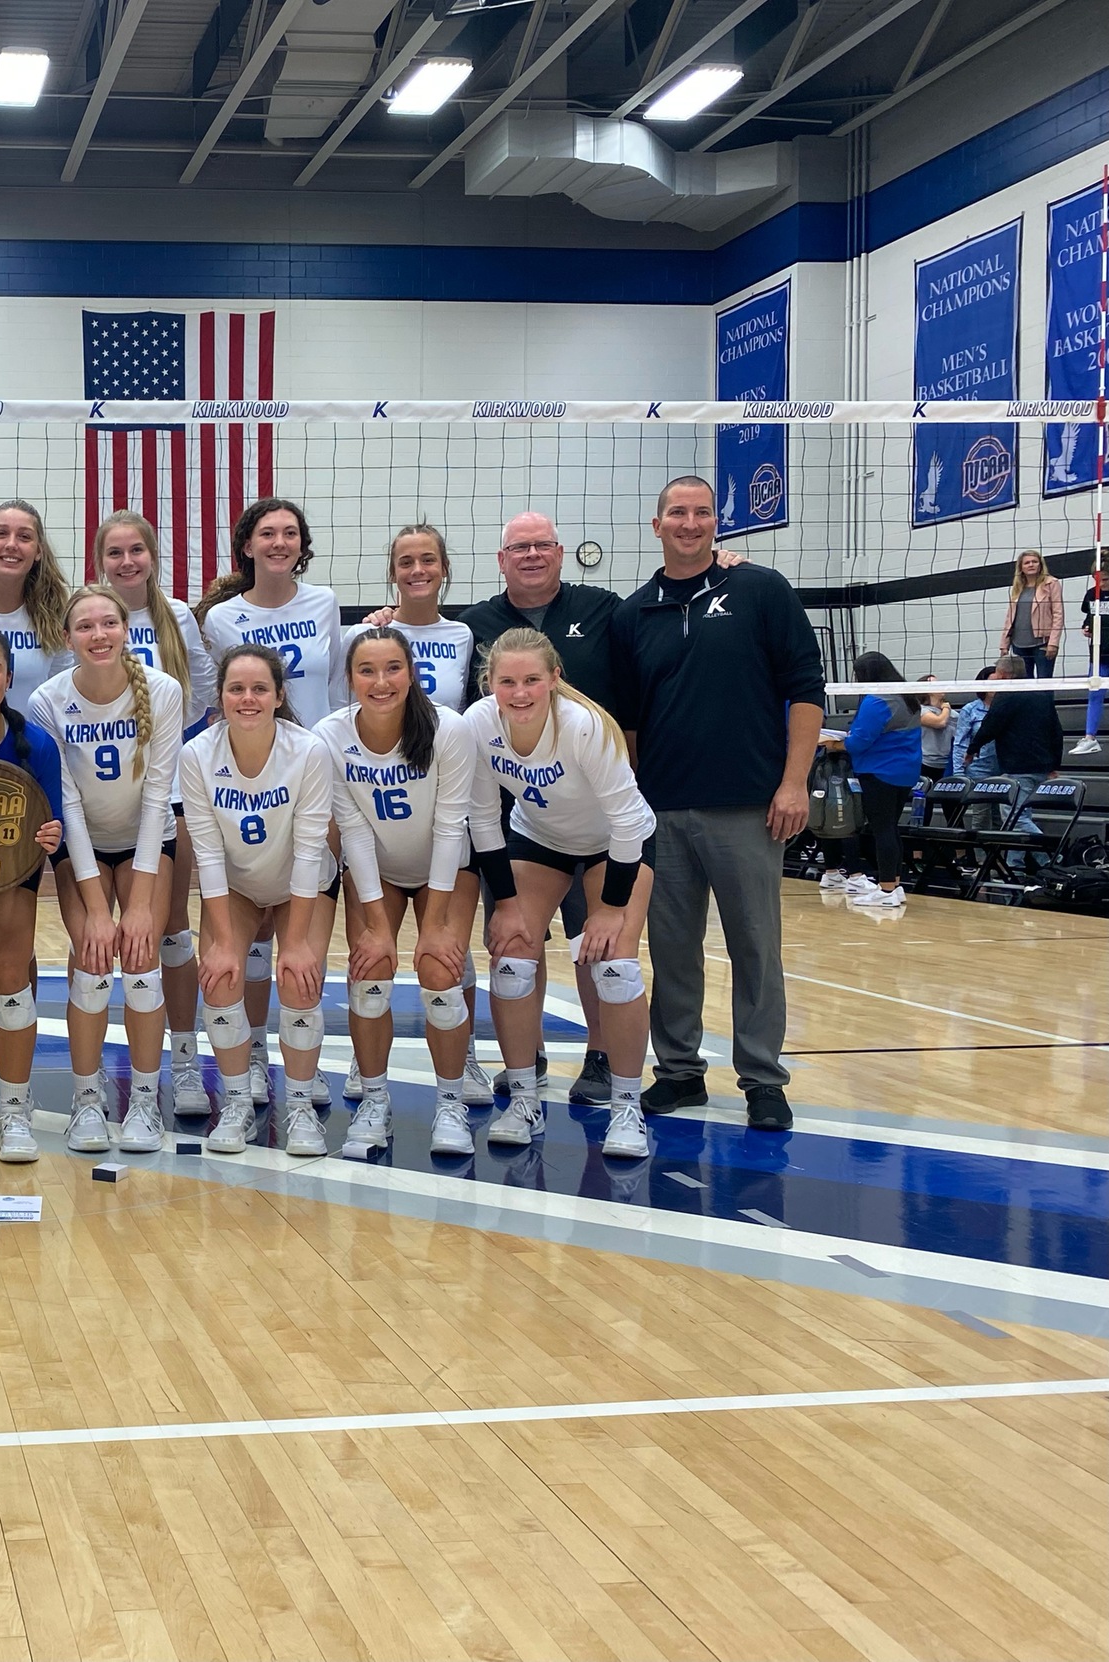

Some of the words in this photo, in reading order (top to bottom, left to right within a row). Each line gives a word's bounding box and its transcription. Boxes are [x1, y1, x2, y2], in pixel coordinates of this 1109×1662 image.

[929, 254, 1004, 298] NATIONAL
[921, 271, 1011, 322] CHAMPIONS
[726, 311, 778, 345] NATIONAL
[720, 326, 784, 364] CHAMPIONS
[941, 343, 988, 374] MEN'S
[918, 359, 1009, 400] BASKETBALL
[89, 402, 105, 418] K
[192, 401, 289, 418] KIRKWOOD
[373, 402, 388, 418] K
[472, 401, 567, 418] KIRKWOOD
[646, 402, 661, 418] K
[743, 402, 834, 418] KIRKWOOD
[912, 402, 927, 418] K
[1006, 401, 1093, 417] KIRKWOOD
[738, 424, 761, 445] 2019
[964, 453, 1011, 493] NJCAA
[750, 477, 782, 511] NJCAA
[707, 593, 729, 614] K
[241, 619, 317, 646] KIRKWOOD
[568, 622, 582, 635] K
[65, 718, 140, 744] KIRKWOO
[95, 744, 121, 781] 9
[490, 754, 565, 788] KIRKWOOD
[213, 786, 289, 811] KIRKWOOD
[522, 785, 549, 809] 4
[933, 782, 966, 792] EAGLES
[973, 782, 1013, 794] EAGLES
[1035, 784, 1076, 796] EAGLES
[372, 788, 412, 821] 16
[2, 828, 15, 840] 11
[240, 814, 267, 845] 8
